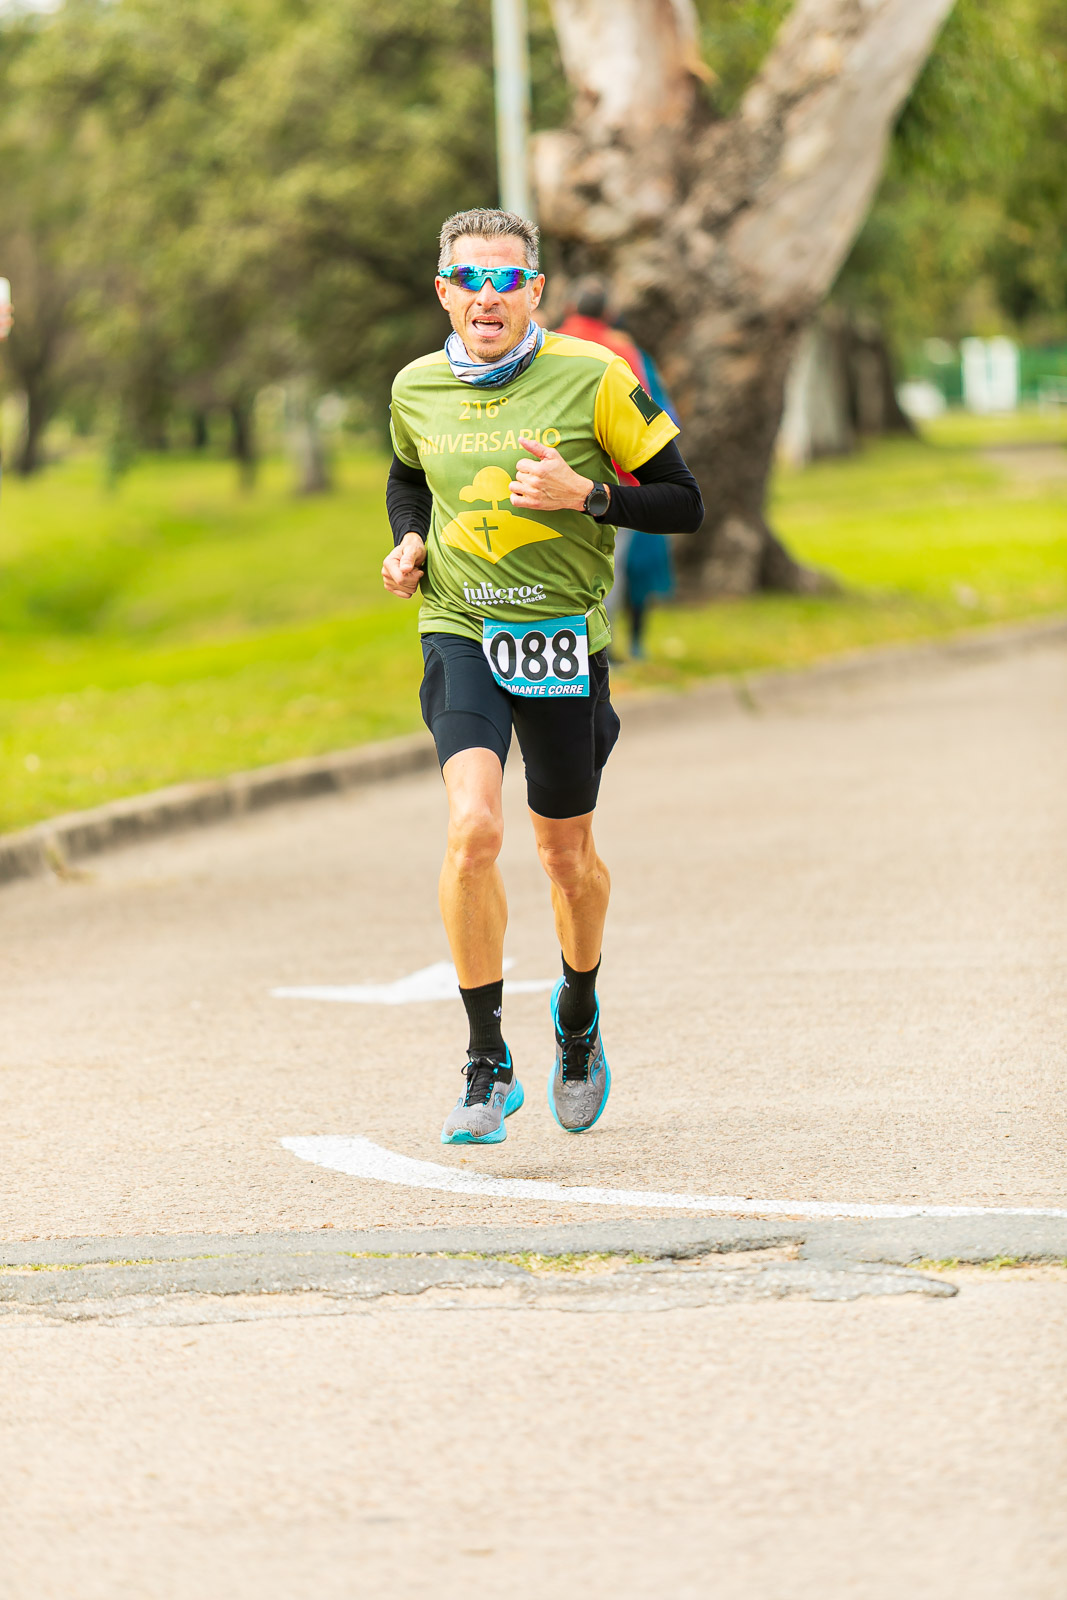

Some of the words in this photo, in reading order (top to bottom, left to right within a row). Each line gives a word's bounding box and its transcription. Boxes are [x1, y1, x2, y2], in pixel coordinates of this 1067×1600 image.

[458, 396, 510, 421] 216°
[420, 427, 561, 456] ANIVERSARIO
[462, 581, 544, 603] julicroc
[522, 593, 547, 604] snacks
[489, 628, 580, 681] 088
[547, 684, 584, 695] CORRE
